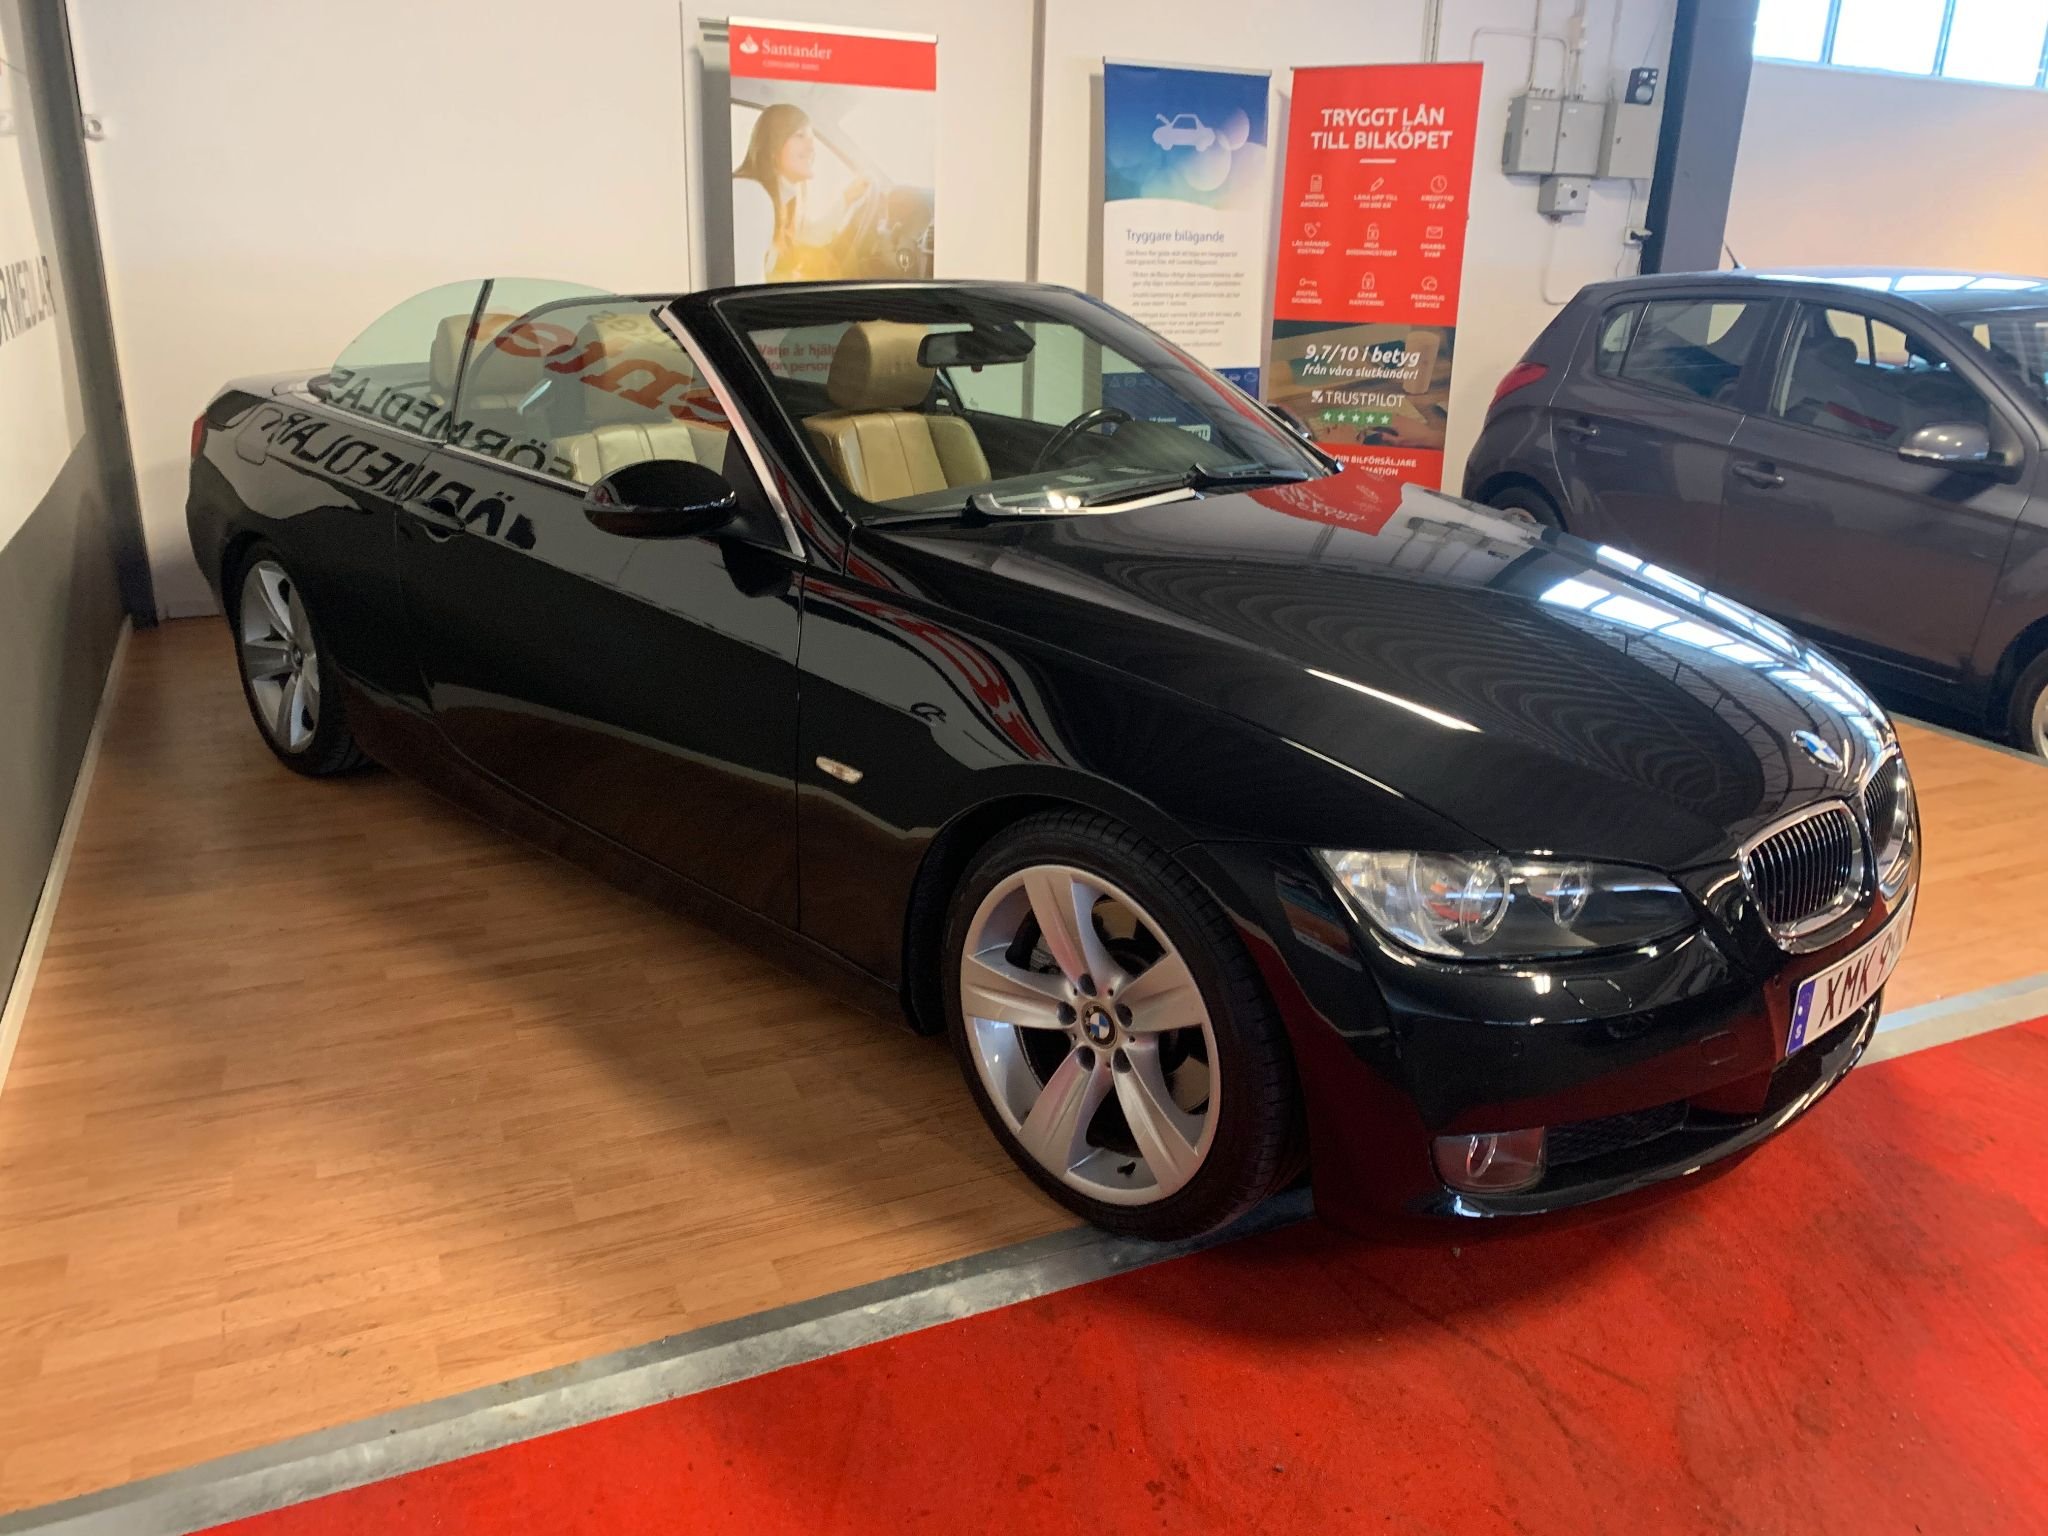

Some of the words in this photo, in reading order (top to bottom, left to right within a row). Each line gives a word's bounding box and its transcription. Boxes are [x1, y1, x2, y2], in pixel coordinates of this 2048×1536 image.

[762, 38, 832, 60] Santander
[1321, 107, 1398, 127] TRYGGT
[1402, 103, 1445, 126] LÅN
[1311, 131, 1349, 149] TILL
[1354, 126, 1453, 149] BILKÖPET
[1126, 229, 1172, 244] Tryggare
[1174, 230, 1225, 245] bilägande
[1304, 343, 1359, 363] 9,7/10
[1362, 345, 1370, 361] i
[1370, 345, 1420, 368] betyg
[1302, 362, 1327, 377] från
[1329, 366, 1353, 377] våra
[1355, 366, 1419, 380] slutkunder!
[1325, 391, 1406, 408] TRUSTPILOT
[1350, 455, 1417, 468] BILFÖRSÄLJARE
[1818, 946, 1877, 1029] XMK
